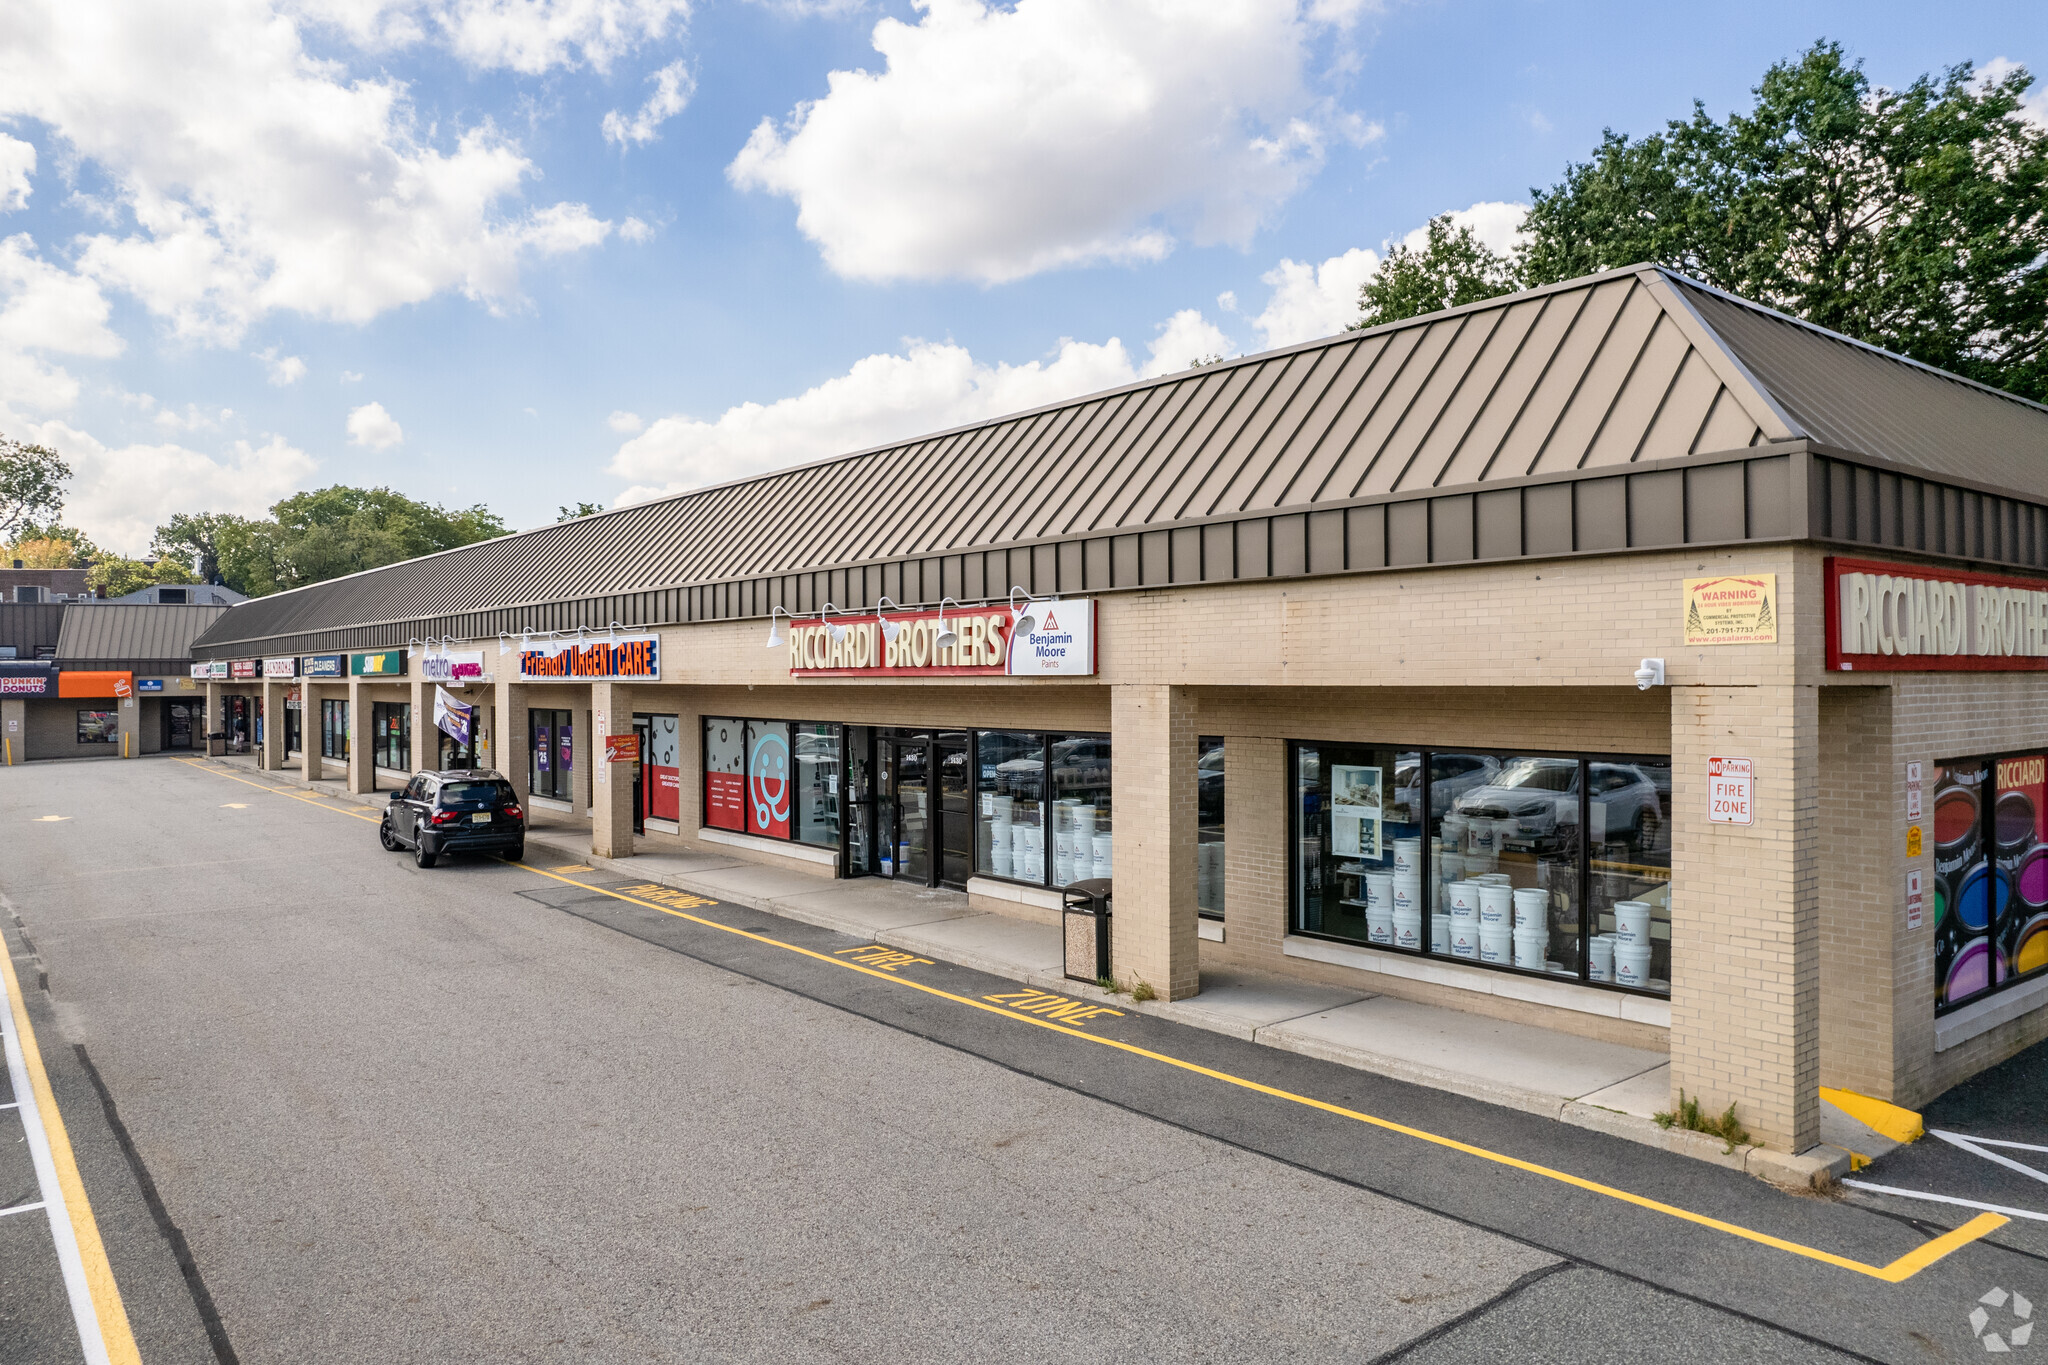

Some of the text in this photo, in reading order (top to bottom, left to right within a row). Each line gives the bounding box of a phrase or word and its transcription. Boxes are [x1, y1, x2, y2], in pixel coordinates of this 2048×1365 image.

[1702, 590, 1756, 600] WARNING
[1846, 572, 1967, 656] RICCIARDI
[790, 615, 1005, 669] RICCIARDI BROTHERS
[1030, 632, 1072, 647] Benjamin
[1688, 635, 1772, 643] www.cpsalarm.com
[526, 640, 651, 676] Friendly URGENT CARE
[1036, 646, 1066, 657] Moore
[265, 660, 294, 674] LAUNDROMAT
[315, 660, 335, 671] CLEANERS
[423, 654, 448, 676] metro
[1042, 660, 1059, 668] Paints
[1710, 761, 1750, 774] NO PARKING
[1912, 767, 1917, 777] NO
[1997, 759, 2045, 790] RICCIARDI
[1717, 784, 1744, 797] FIRE
[1714, 800, 1747, 814] ZONE
[1936, 854, 1962, 876] Benjamin
[1912, 878, 1917, 891] NO
[616, 884, 719, 909] PARKING
[834, 945, 935, 971] FIRE
[982, 988, 1125, 1026] ZONE
